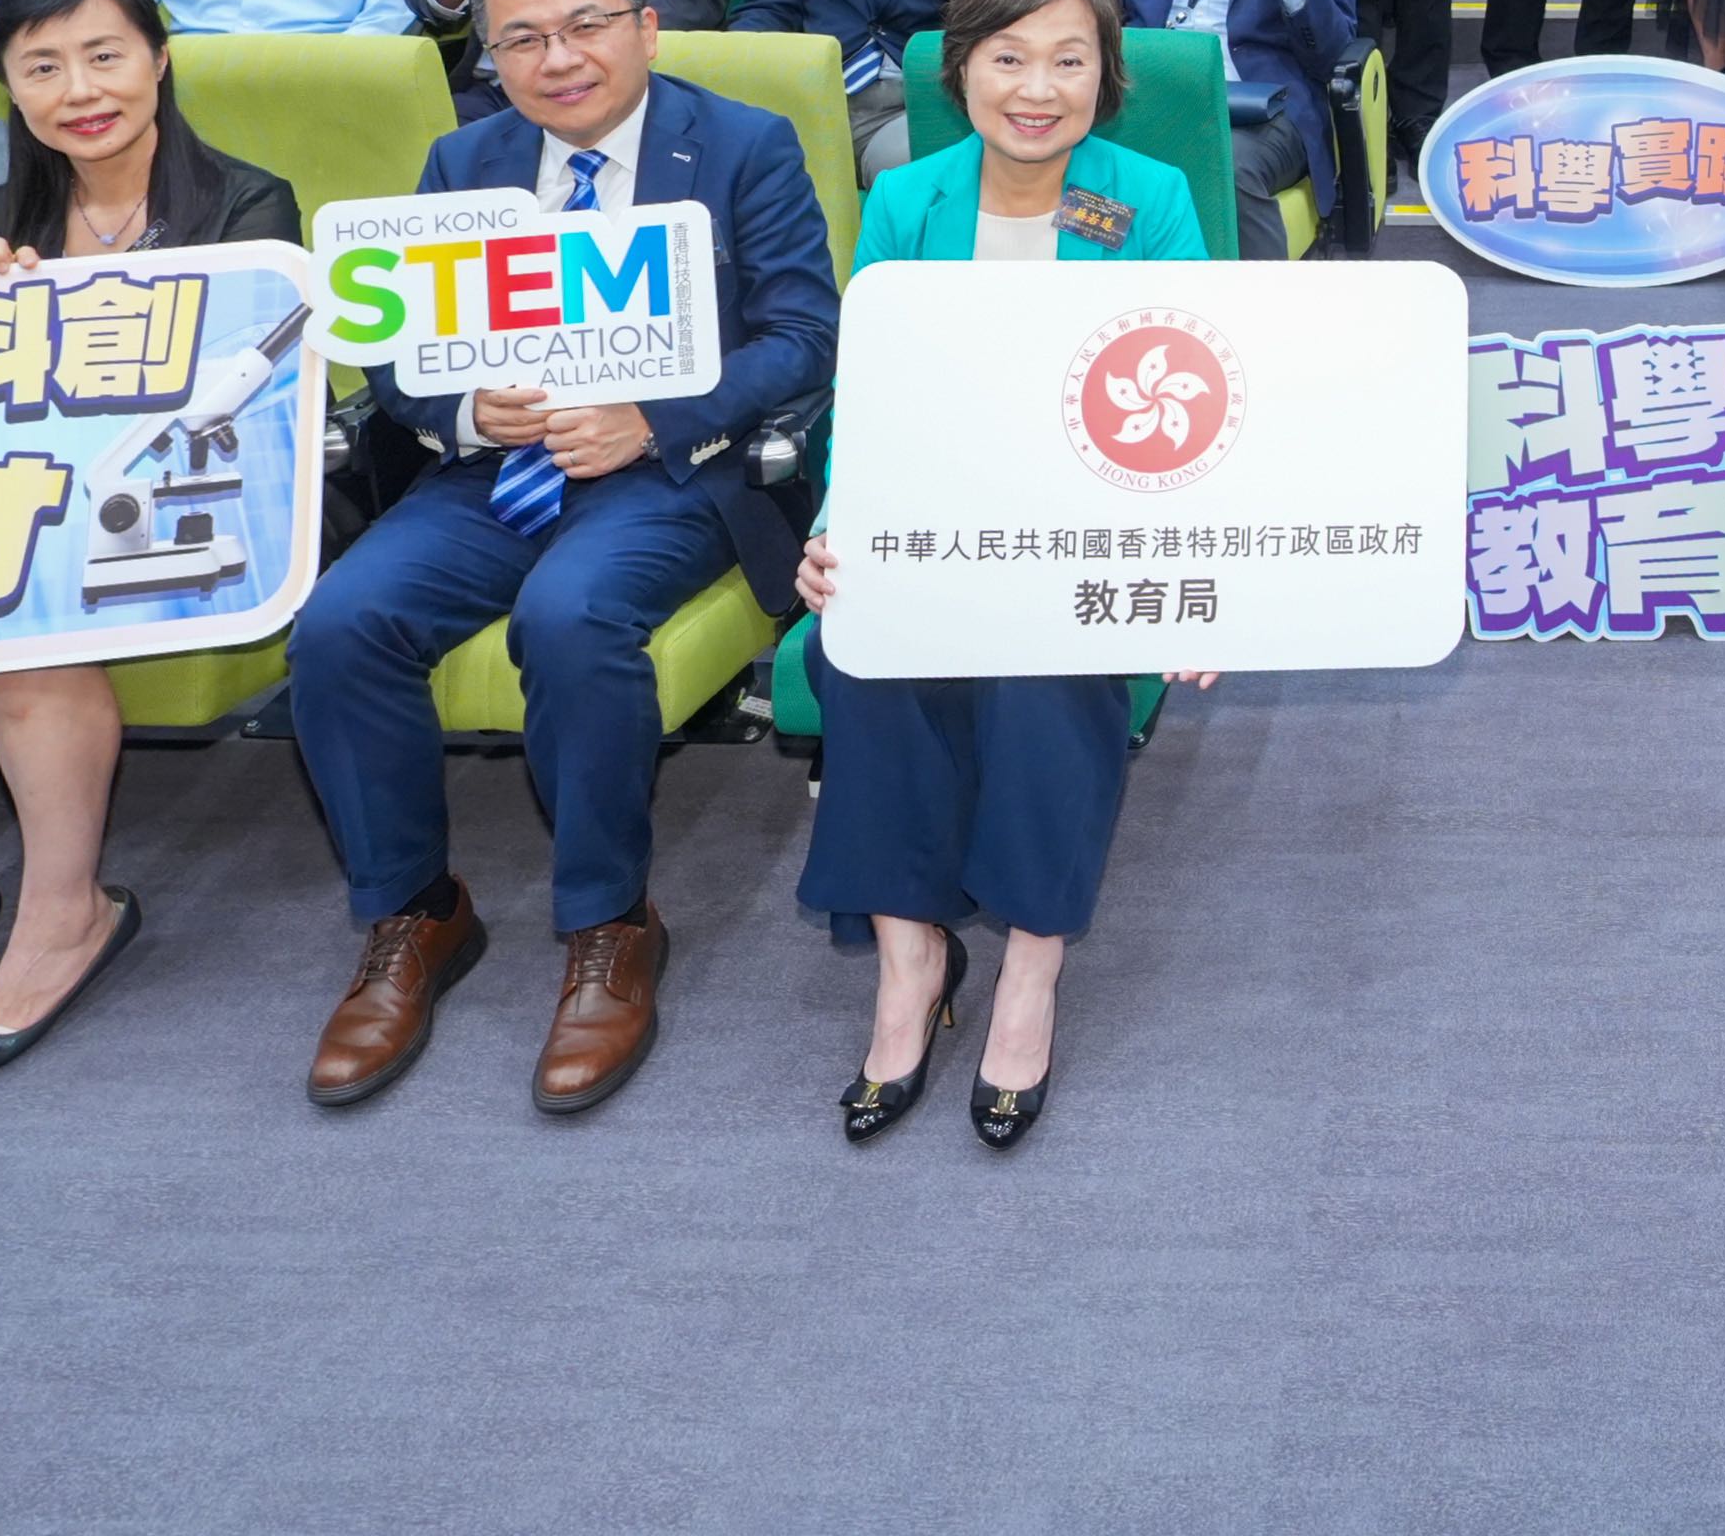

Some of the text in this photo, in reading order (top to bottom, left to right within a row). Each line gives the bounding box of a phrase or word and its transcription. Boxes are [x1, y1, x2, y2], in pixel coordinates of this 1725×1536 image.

[336, 208, 519, 242] HONG KONG
[327, 224, 671, 344] STEM
[672, 222, 696, 375] 香港科技創新教育聯盟
[417, 321, 673, 375] EDUCATION
[539, 356, 675, 389] ALLIANCE
[1097, 458, 1210, 490] HONG KONG
[871, 522, 1424, 562] 中華人民共和國香港特別行政區政府
[1074, 577, 1220, 626] 教育局
